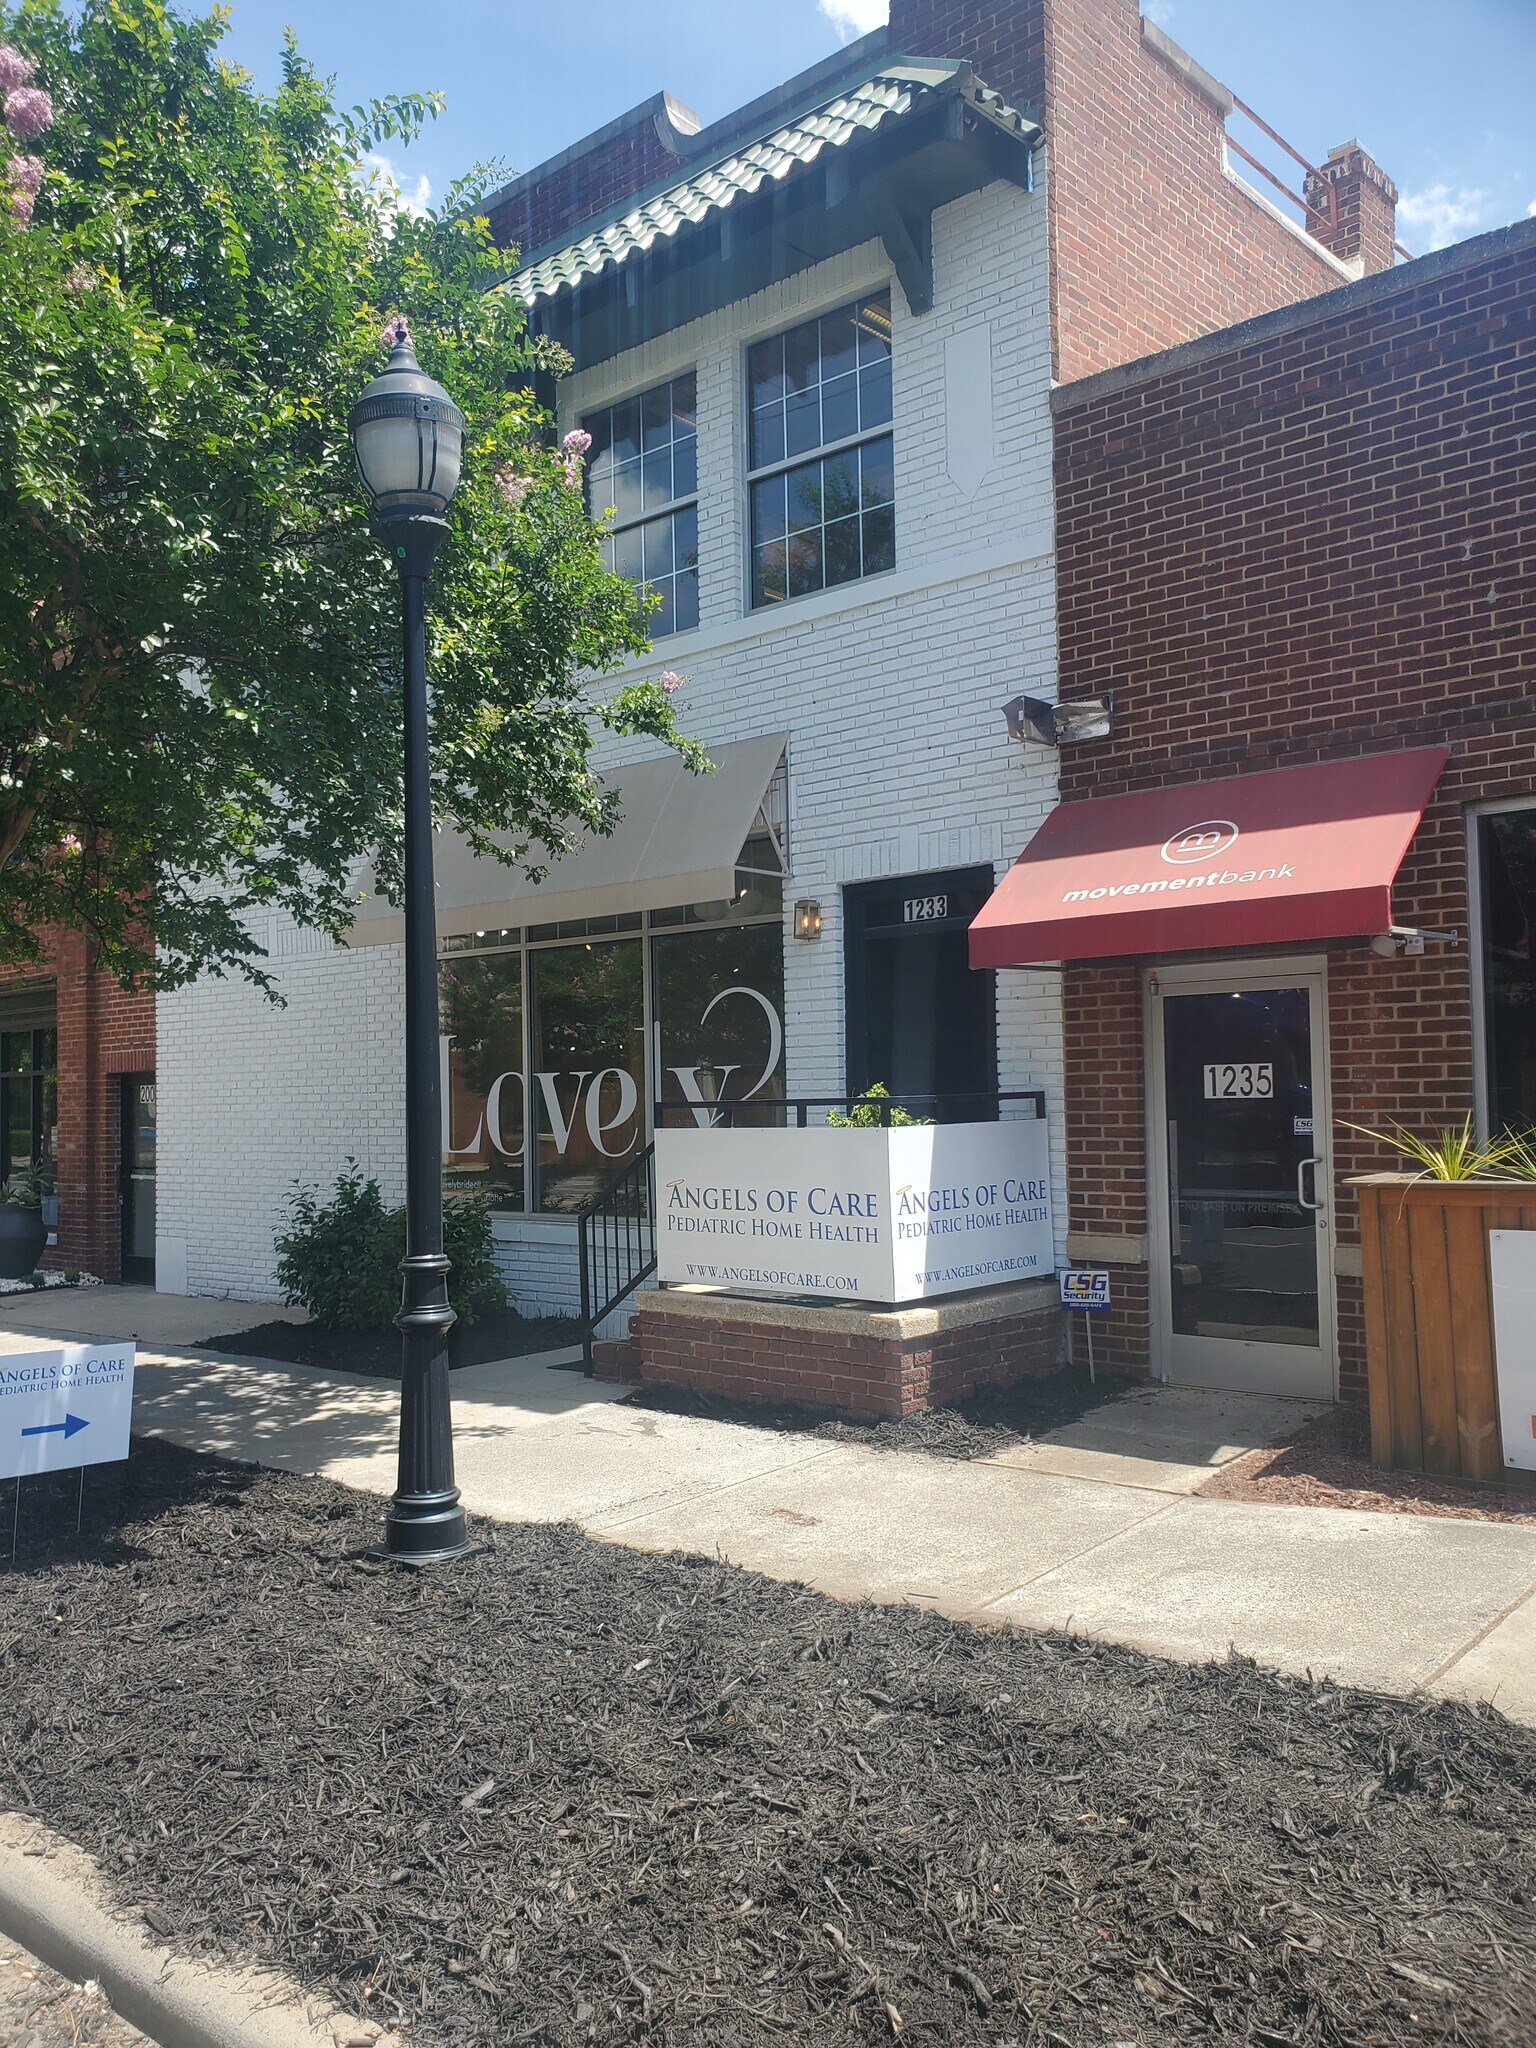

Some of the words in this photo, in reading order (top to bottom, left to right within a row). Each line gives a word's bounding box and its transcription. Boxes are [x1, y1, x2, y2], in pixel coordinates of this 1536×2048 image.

[1060, 863, 1298, 903] movementbank
[905, 896, 946, 921] 1233
[140, 1085, 155, 1103] 200
[1208, 1065, 1272, 1097] 1235
[667, 1183, 758, 1213] ANGELS
[766, 1189, 799, 1214] OF
[807, 1187, 879, 1218] CARE
[897, 1187, 970, 1216] ANGELS
[975, 1184, 998, 1207] OF
[1003, 1179, 1047, 1204] CARE
[667, 1214, 746, 1235] PEDIATRIC
[751, 1218, 803, 1239] HOME
[809, 1221, 880, 1244] HEALTH
[897, 1217, 962, 1239] PEDIATRIC
[965, 1212, 1002, 1231] HOME
[1004, 1206, 1048, 1225] HEALTH
[686, 1263, 859, 1291] WWW.ANGELSOFCARE.COM
[915, 1255, 1038, 1285] WWW.ANGELSOFCARE.COM
[1063, 1274, 1107, 1291] CSG
[1063, 1290, 1105, 1302] Security
[0, 1366, 56, 1384] ANGELS
[61, 1363, 82, 1377] OF
[86, 1358, 126, 1374] CARE
[0, 1382, 47, 1396] EDIATRIC
[51, 1378, 83, 1390] HOME
[85, 1373, 125, 1386] HEALTH
